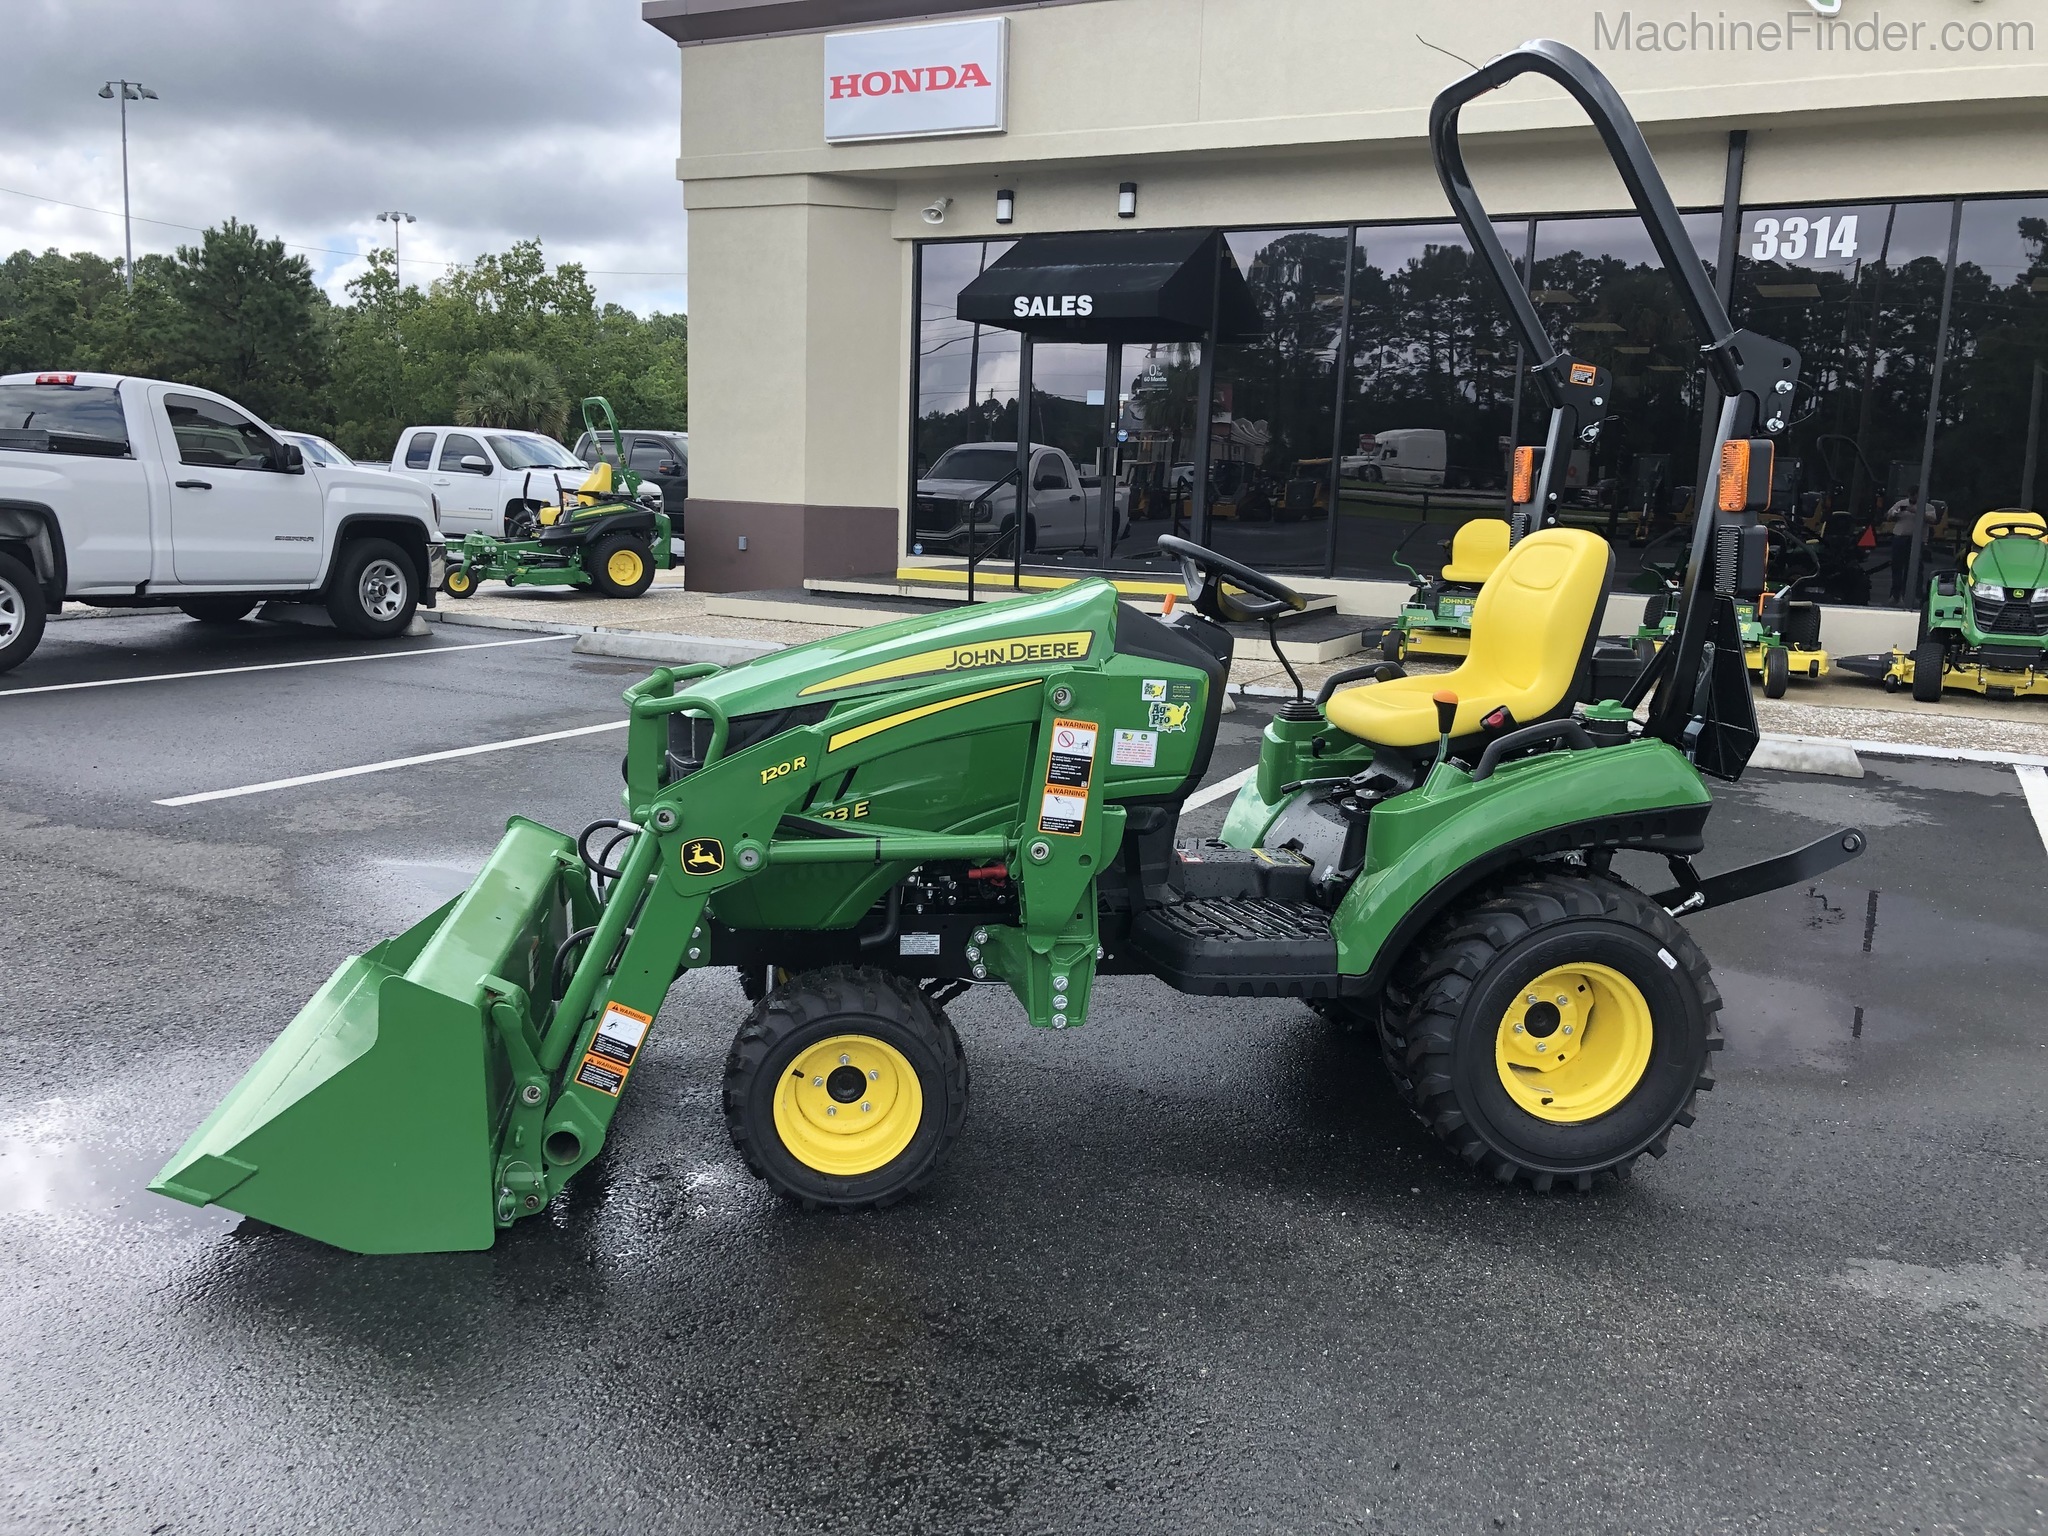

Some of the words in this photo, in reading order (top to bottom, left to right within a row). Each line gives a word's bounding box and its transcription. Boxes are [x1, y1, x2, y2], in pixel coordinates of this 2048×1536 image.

[829, 62, 991, 99] HONDA
[1751, 215, 1858, 261] 3314
[1013, 294, 1093, 317] SALES
[945, 647, 1005, 668] JOHN
[1010, 641, 1079, 661] DEERE
[1151, 704, 1170, 716] Ag-
[1063, 721, 1096, 730] WARNING
[1151, 714, 1170, 725] Pro
[760, 762, 791, 785] 120
[793, 756, 807, 771] R
[1053, 788, 1086, 797] WARNING
[854, 800, 870, 818] E
[619, 1007, 647, 1022] WARNING
[596, 1058, 623, 1074] WARNING
